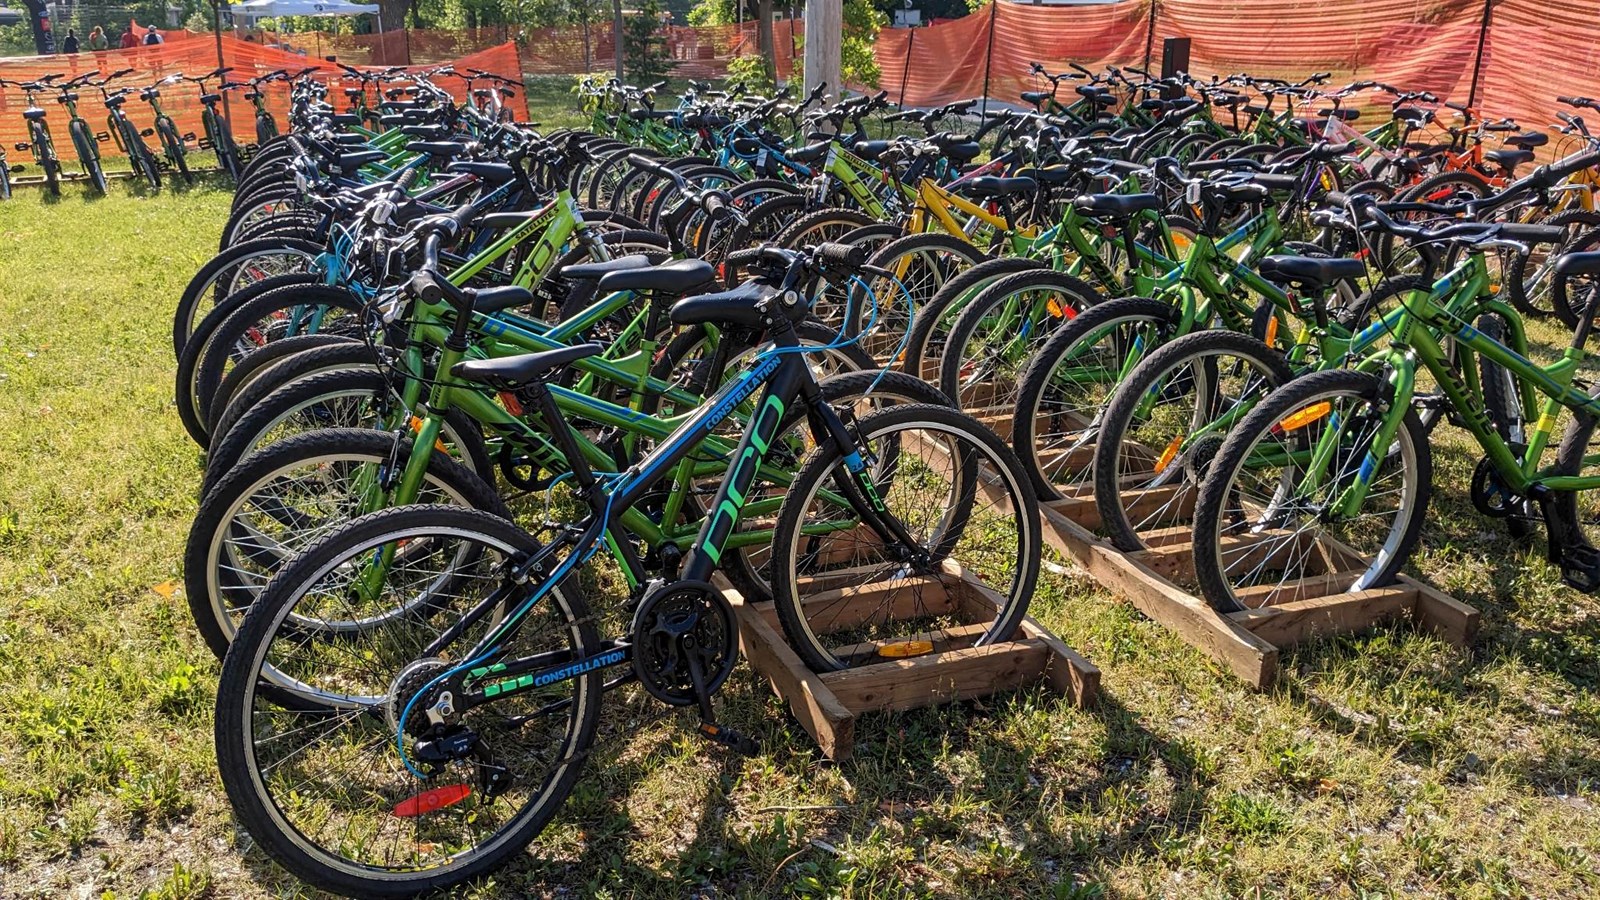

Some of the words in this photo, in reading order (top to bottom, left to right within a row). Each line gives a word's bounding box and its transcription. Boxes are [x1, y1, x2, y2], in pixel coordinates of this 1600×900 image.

[515, 211, 555, 241] SATELLITE
[705, 356, 782, 431] CONSTELLATION
[702, 394, 785, 566] DCO
[859, 472, 885, 512] DCO
[534, 650, 626, 687] CONSTELLATION
